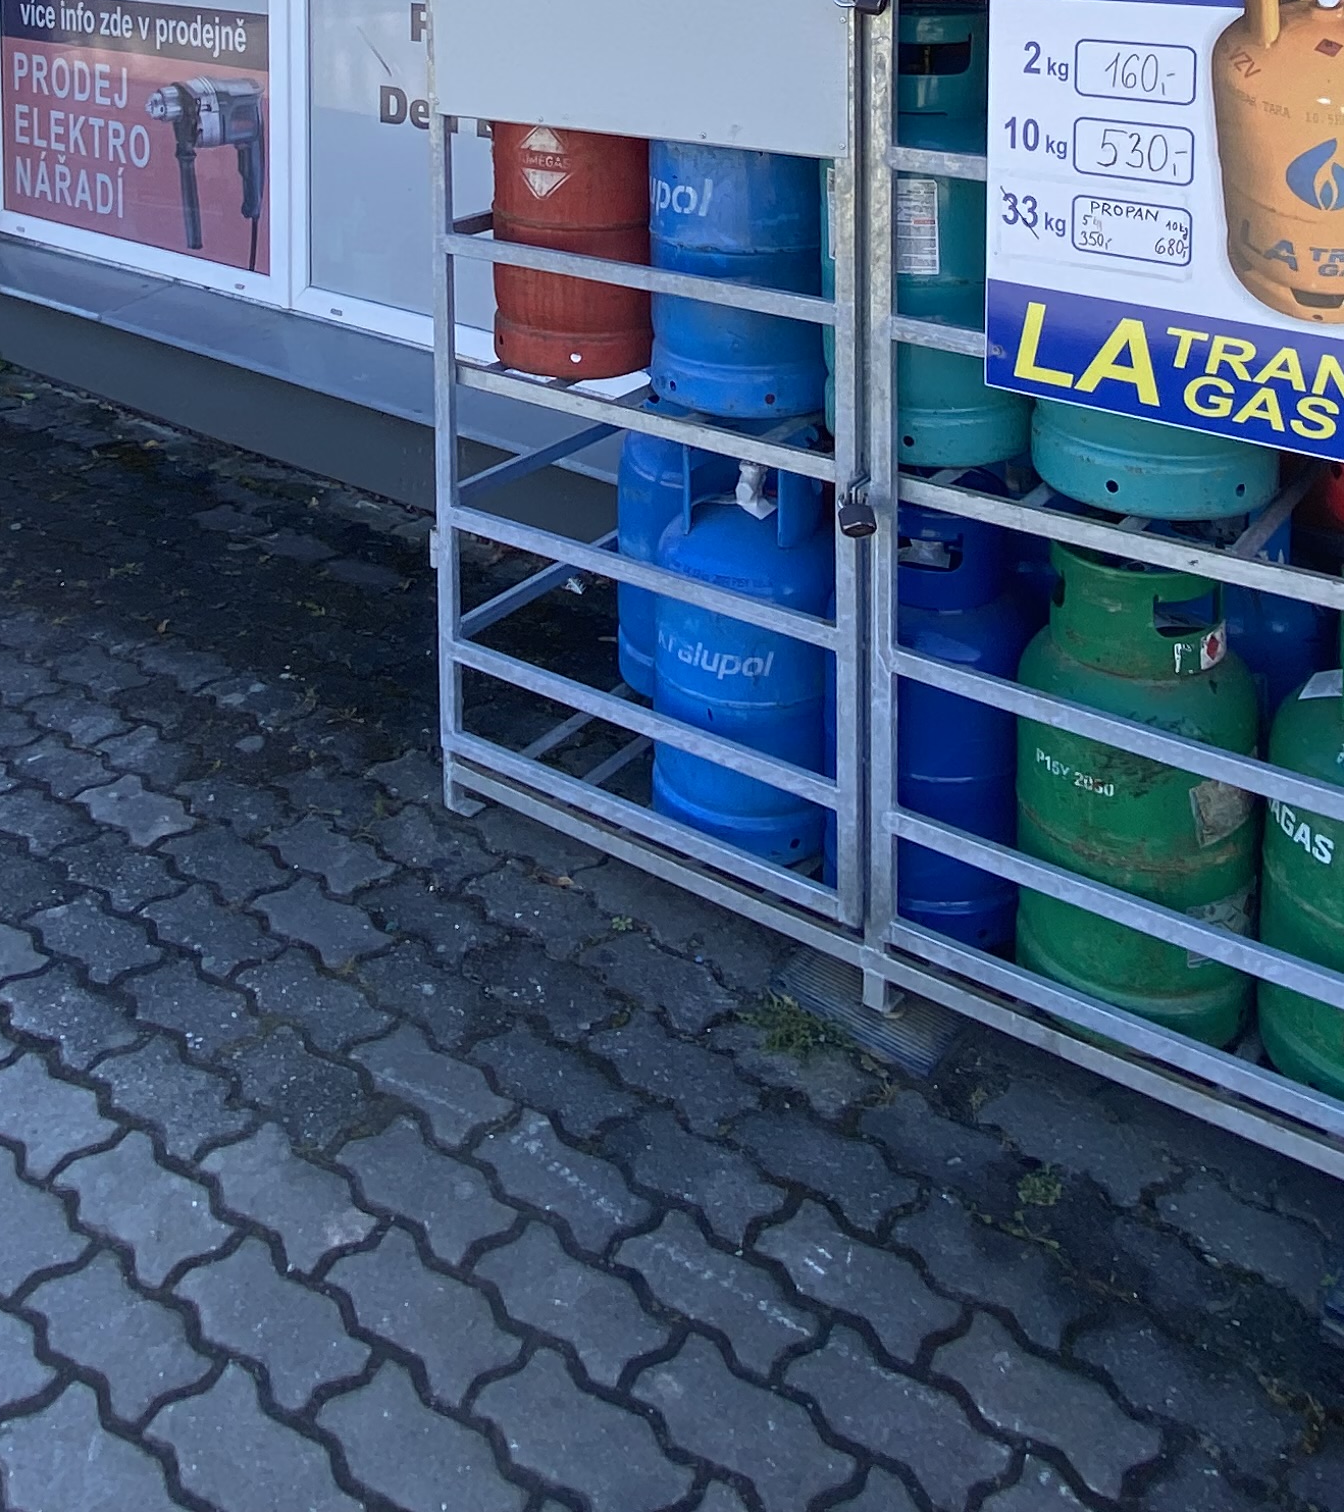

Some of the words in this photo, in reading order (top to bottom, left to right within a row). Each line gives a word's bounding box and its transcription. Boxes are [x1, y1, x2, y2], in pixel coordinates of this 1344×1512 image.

[60, 0, 95, 33] info
[99, 6, 133, 38] zde
[138, 15, 150, 40] v
[156, 15, 247, 58] prodejně
[13, 51, 128, 108] PRODEJ
[1023, 41, 1042, 75] 2
[1047, 57, 1069, 82] kg
[14, 104, 151, 168] ELEKTRO
[1004, 116, 1040, 151] 10
[1045, 134, 1067, 159] kg
[15, 151, 124, 218] NÁŘADÍ
[1090, 201, 1159, 222] PROPAN
[1001, 193, 1039, 228] 33
[1044, 212, 1066, 237] kg
[1013, 301, 1161, 407] LA
[1182, 376, 1340, 440] GAS
[1268, 798, 1334, 864] AGAS
